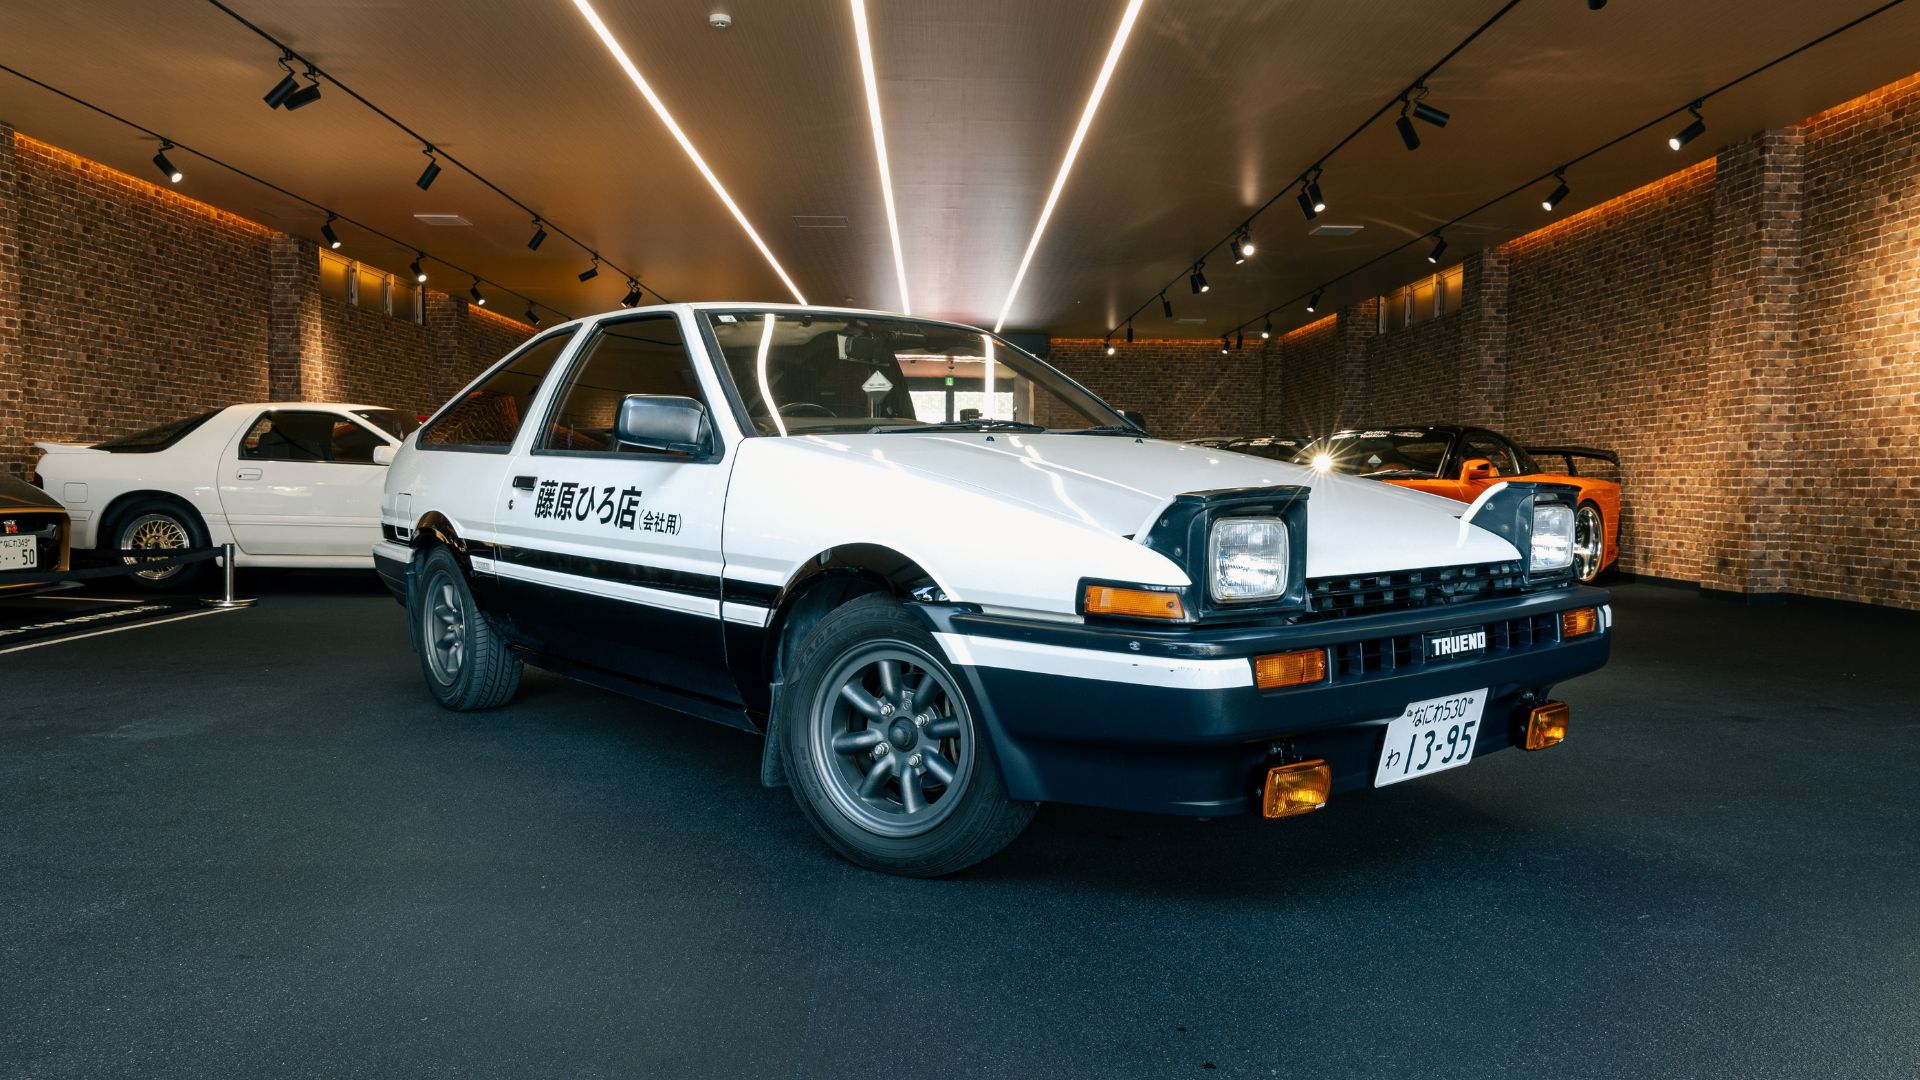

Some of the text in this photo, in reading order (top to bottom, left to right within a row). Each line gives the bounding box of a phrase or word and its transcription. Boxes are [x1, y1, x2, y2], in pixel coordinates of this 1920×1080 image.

[1432, 633, 1486, 656] TRUENO
[1385, 720, 1477, 775] わ 13-95
